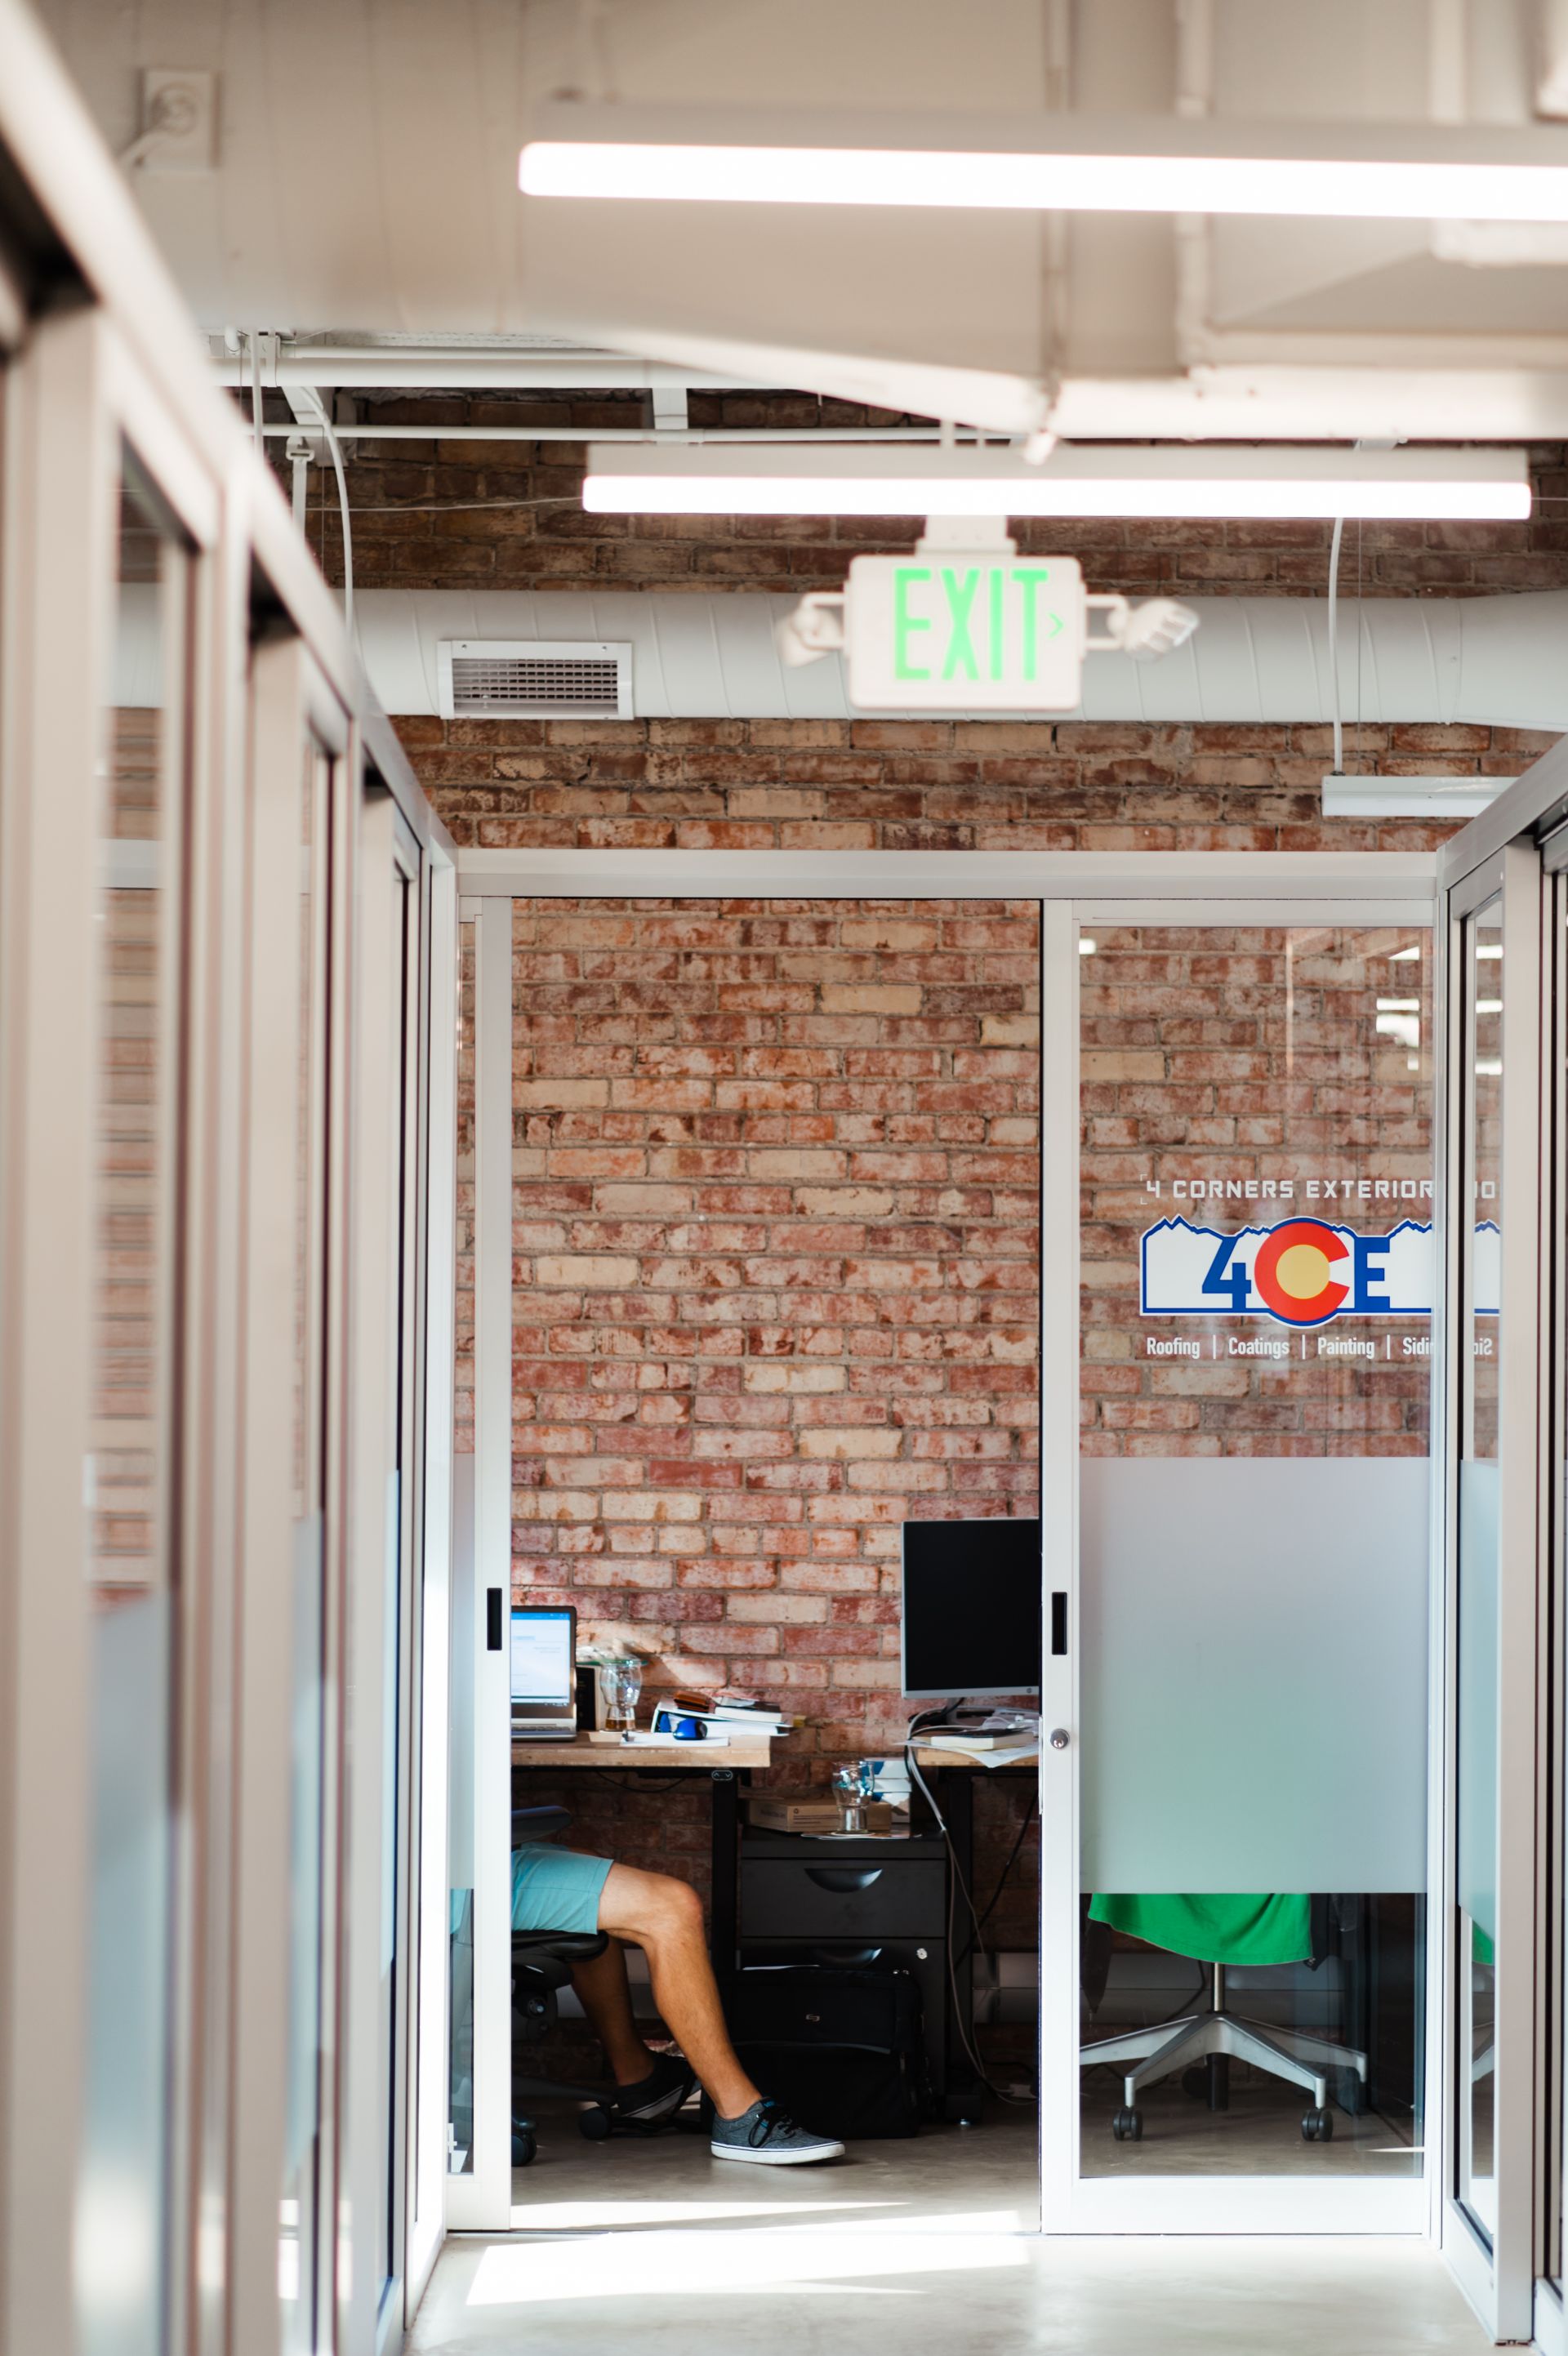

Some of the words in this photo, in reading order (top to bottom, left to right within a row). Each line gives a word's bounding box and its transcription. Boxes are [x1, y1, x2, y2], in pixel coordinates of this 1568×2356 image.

[894, 568, 1049, 681] EXIT
[1147, 1180, 1160, 1198] 4
[1173, 1180, 1294, 1199] CORNERS
[1147, 1337, 1200, 1359] Roofing
[1228, 1337, 1290, 1360] Coatings
[1317, 1337, 1375, 1360] Painting
